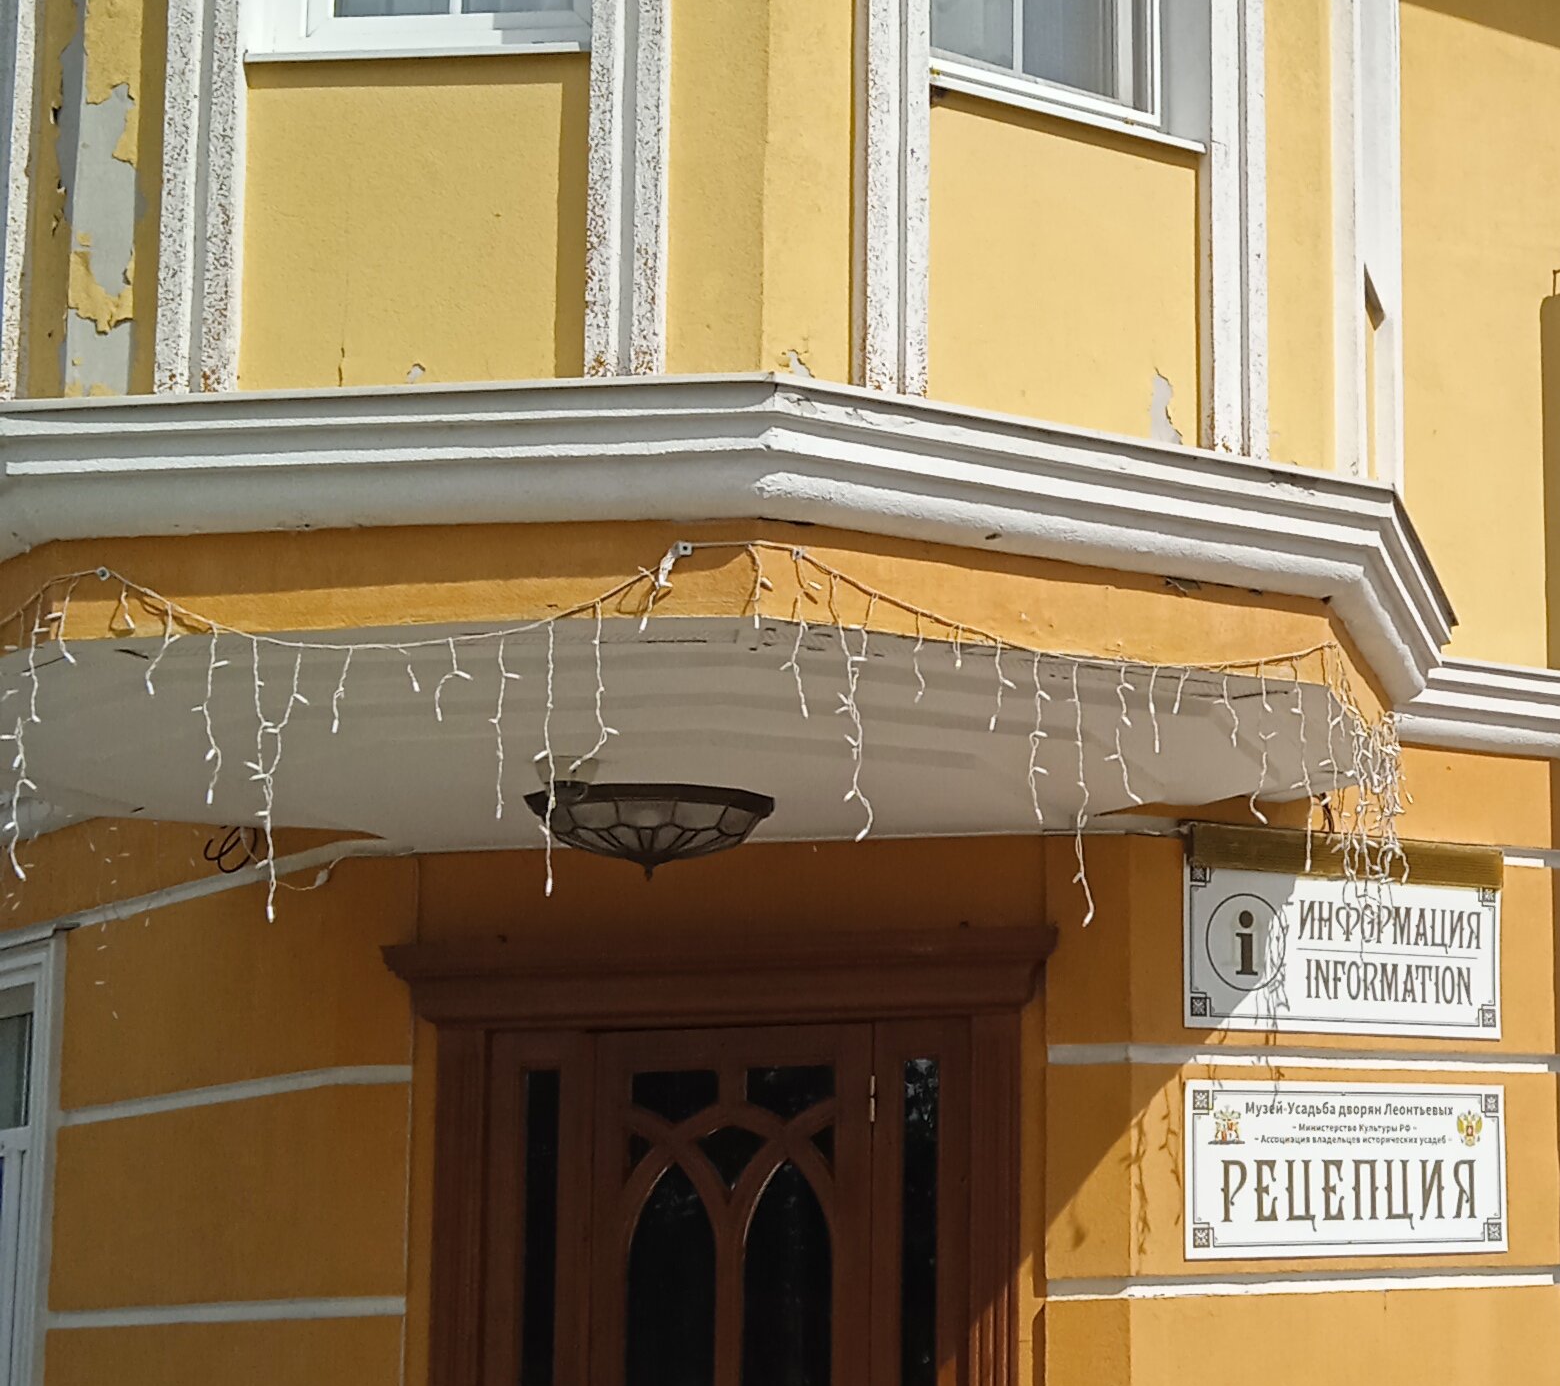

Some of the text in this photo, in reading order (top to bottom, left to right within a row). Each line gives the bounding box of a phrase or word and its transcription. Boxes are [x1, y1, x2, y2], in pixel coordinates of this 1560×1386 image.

[1297, 899, 1482, 954] ИНФОРМАЦИЯ
[1305, 958, 1473, 1006] INFORMATION
[1245, 1100, 1454, 1118] Музей-Усадьба дворян Леонтьевых
[1298, 1123, 1357, 1133] Министерство
[1359, 1124, 1398, 1134] Культуры
[1399, 1124, 1411, 1133] РФ
[1419, 1135, 1447, 1146] усадеб
[1220, 1159, 1478, 1233] РЕЦЕПЦИЯ
